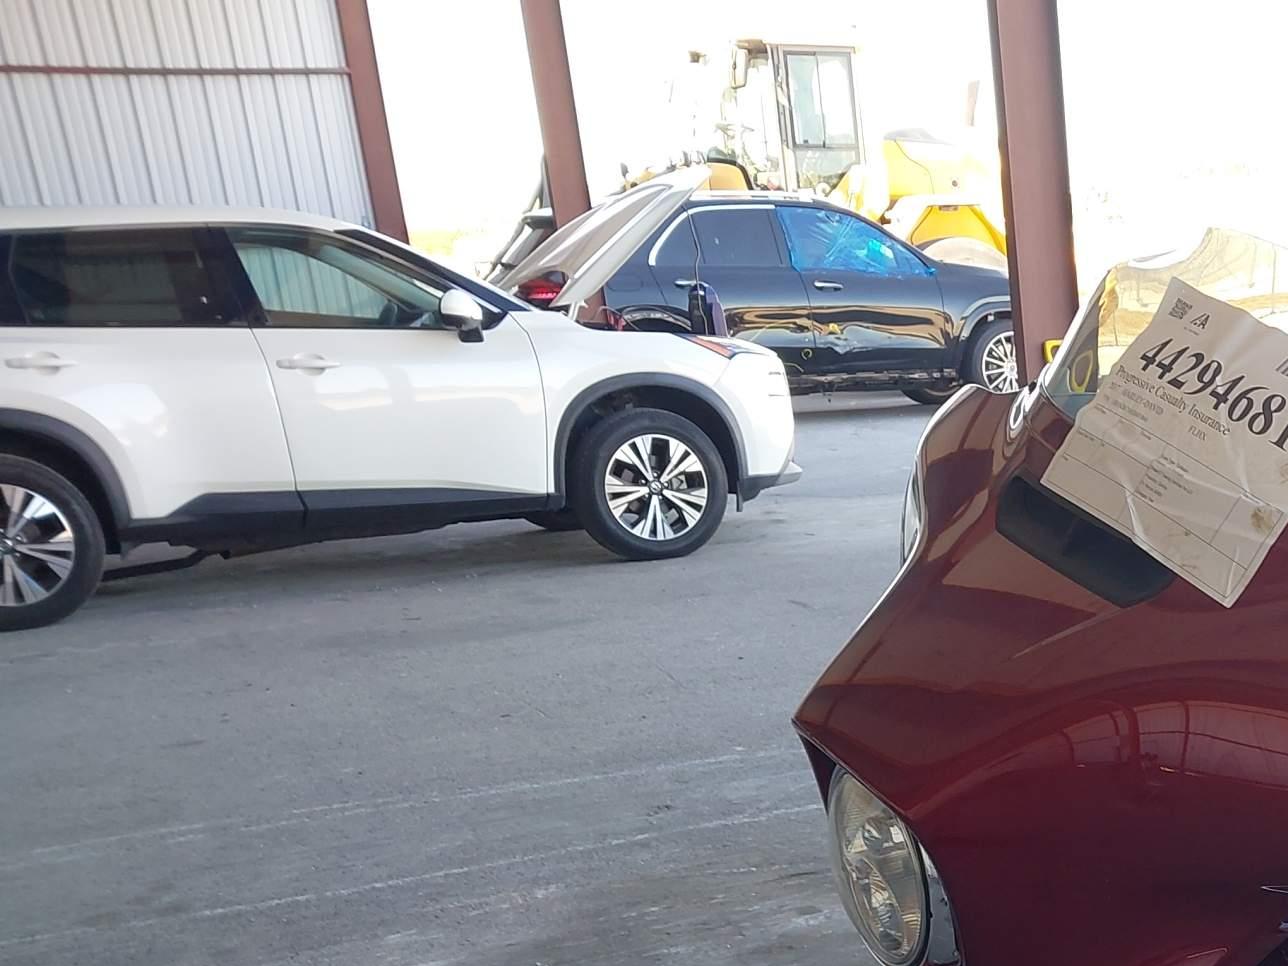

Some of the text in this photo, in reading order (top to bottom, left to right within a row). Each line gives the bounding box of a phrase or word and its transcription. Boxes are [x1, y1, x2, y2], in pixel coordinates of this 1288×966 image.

[1116, 365, 1156, 391] Progressive
[1154, 385, 1187, 413] Casualty
[1188, 403, 1231, 435] Insurance
